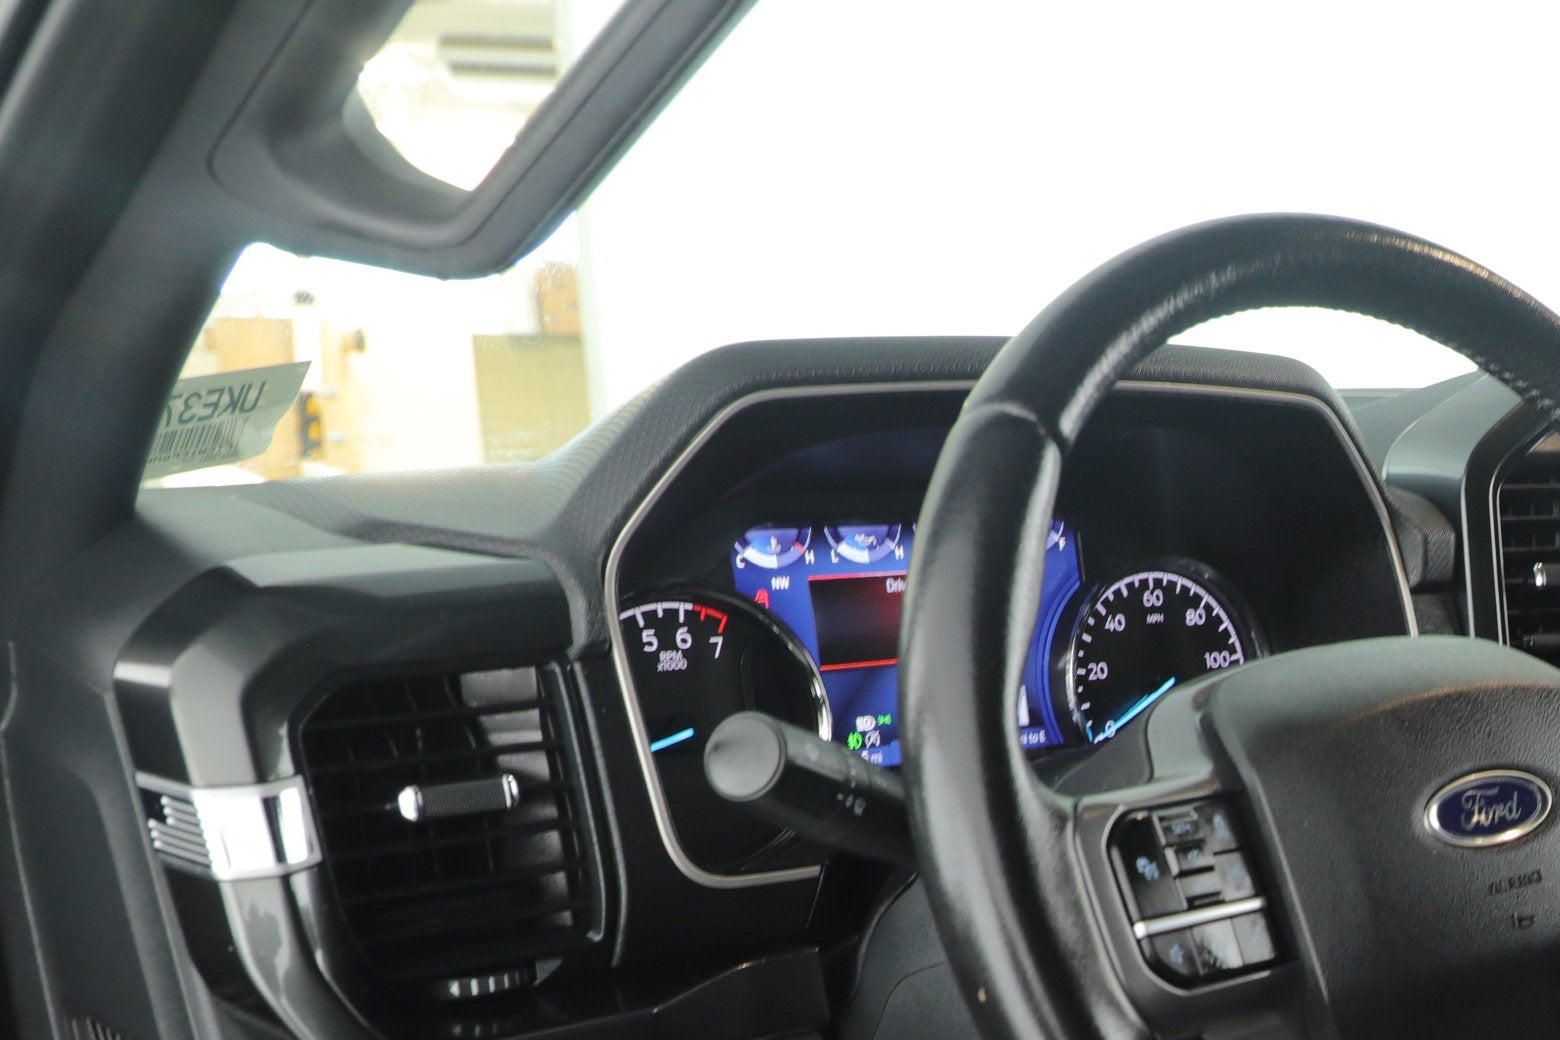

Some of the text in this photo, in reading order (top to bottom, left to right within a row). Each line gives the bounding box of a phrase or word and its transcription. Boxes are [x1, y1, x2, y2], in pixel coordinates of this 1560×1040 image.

[771, 575, 790, 590] NW
[1142, 589, 1164, 608] 60
[1104, 613, 1126, 633] 40
[1146, 612, 1164, 625] MPH
[1185, 607, 1207, 627] 80
[641, 628, 659, 653] 5
[675, 626, 693, 650] 6
[708, 635, 724, 659] 7
[659, 649, 683, 661] RPM
[1203, 651, 1231, 670] 100
[1087, 661, 1109, 681] 20
[1460, 786, 1522, 832] Ford
